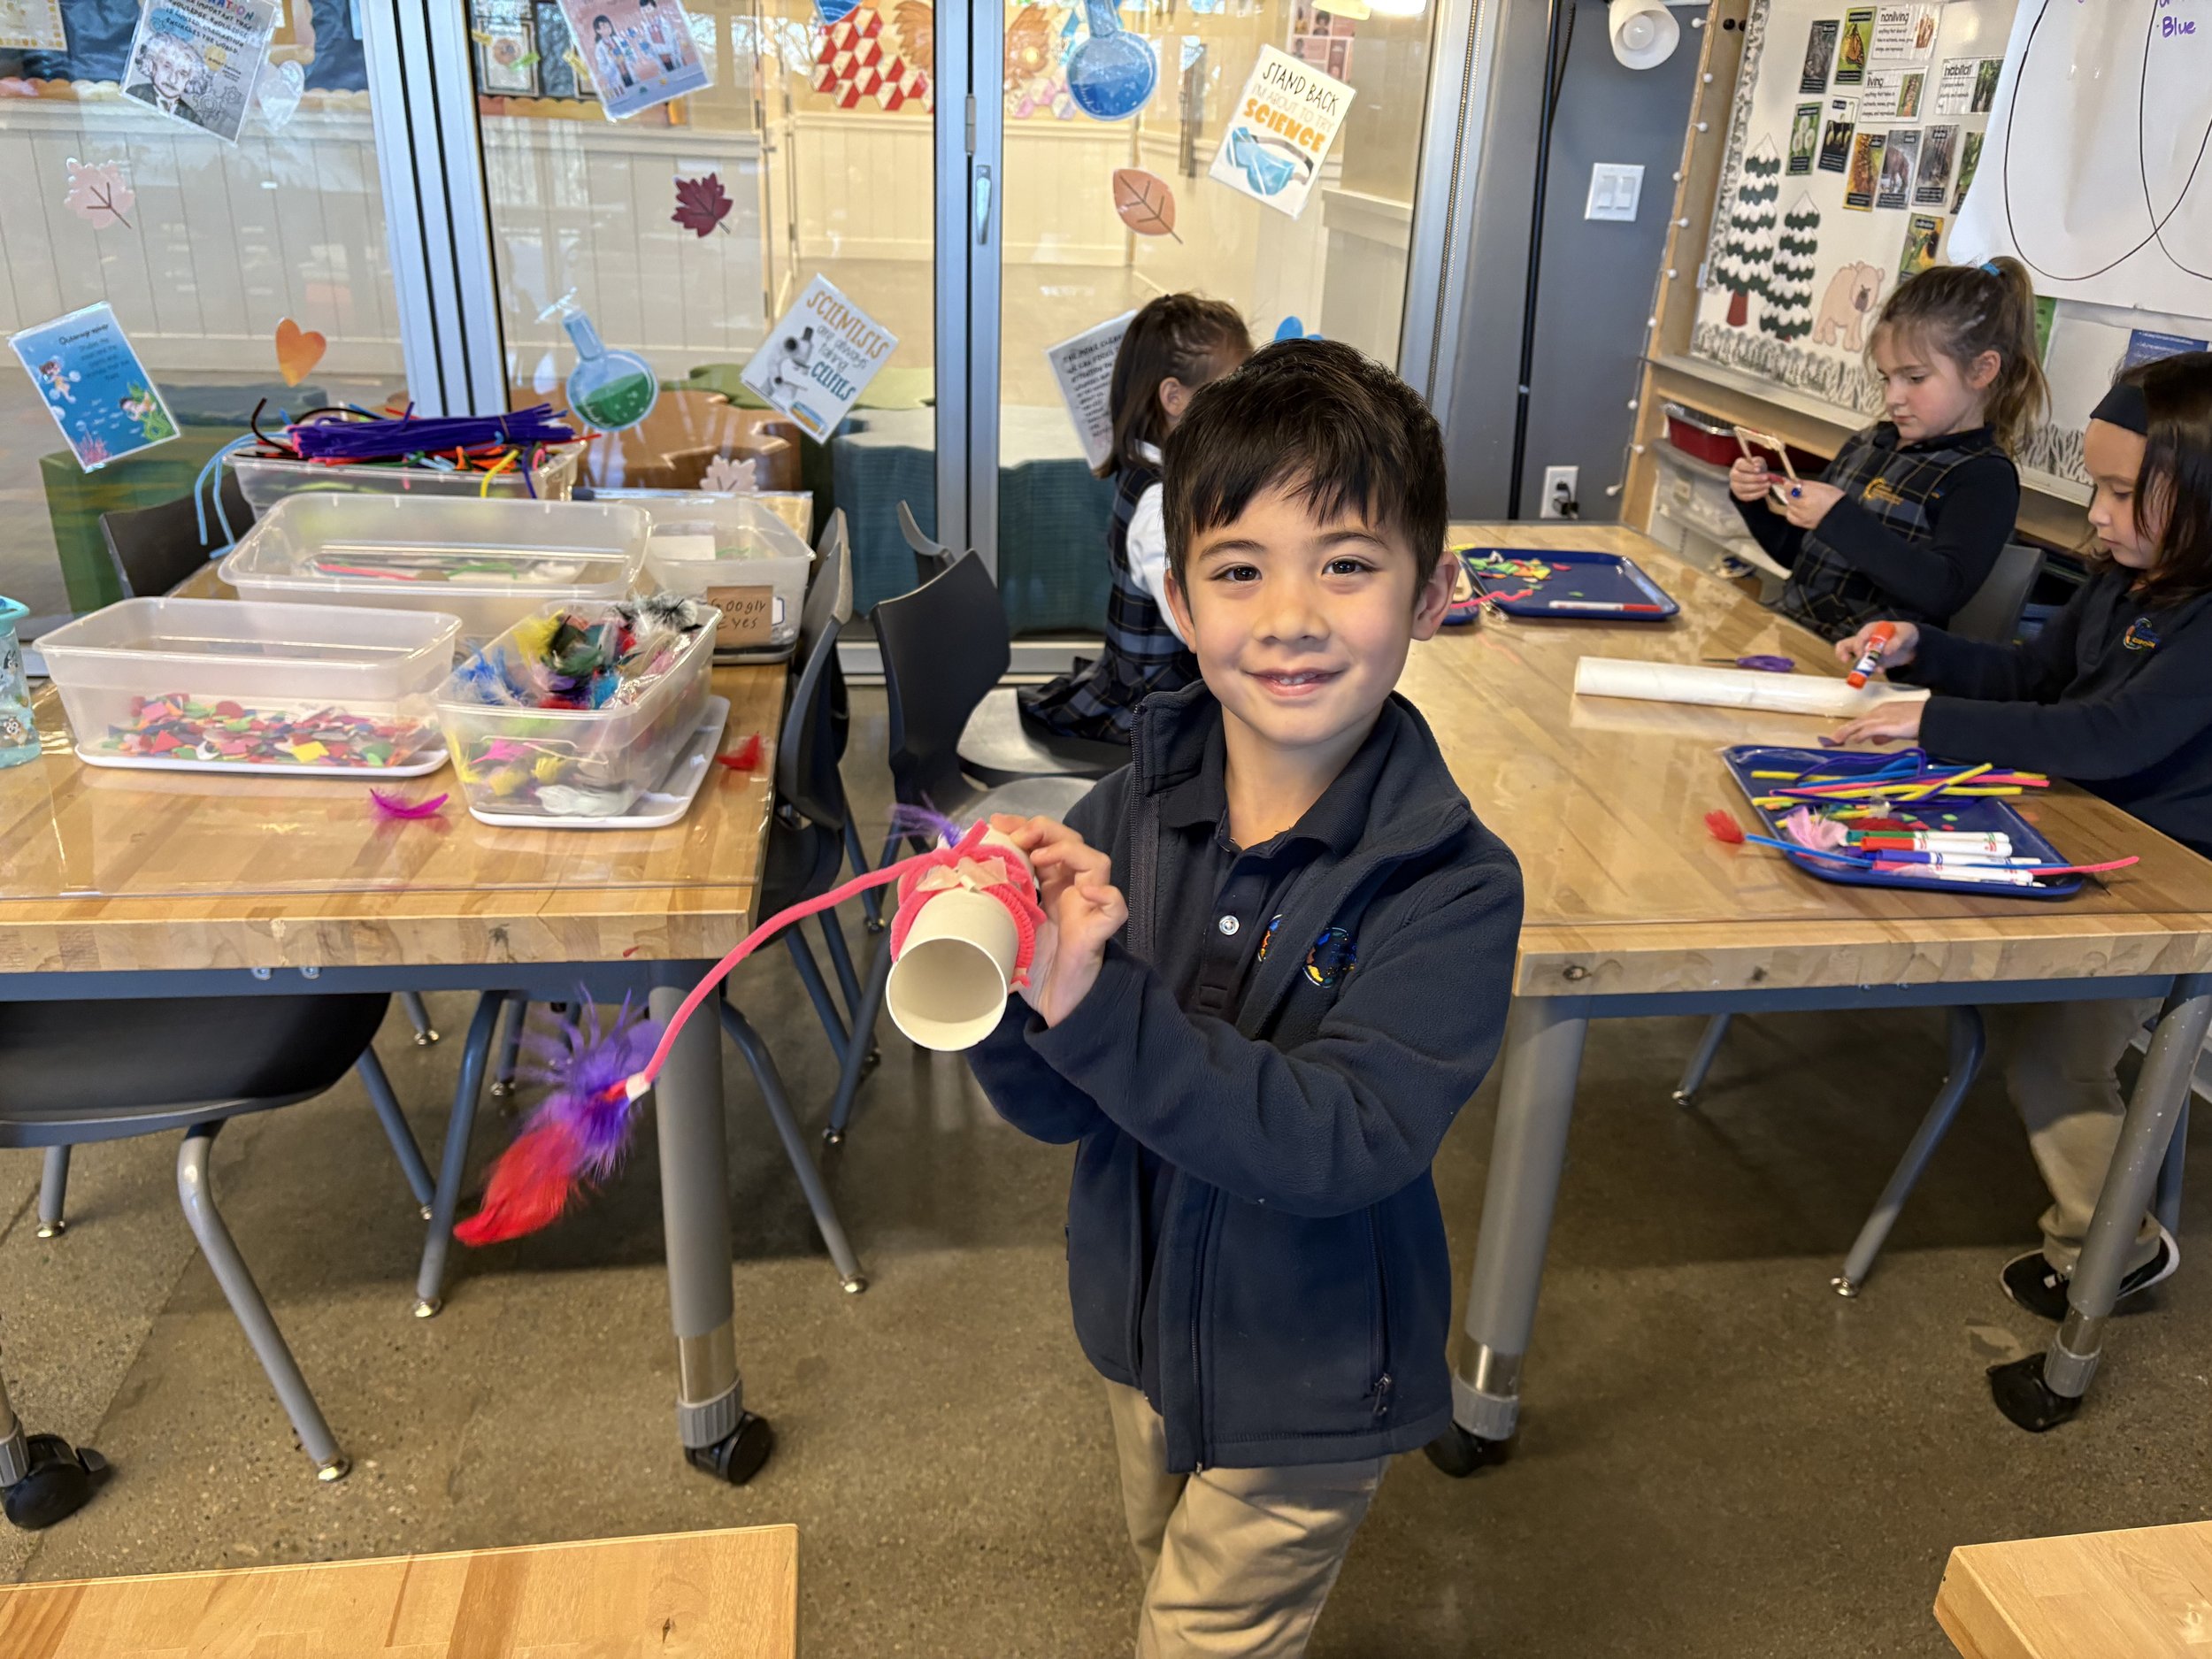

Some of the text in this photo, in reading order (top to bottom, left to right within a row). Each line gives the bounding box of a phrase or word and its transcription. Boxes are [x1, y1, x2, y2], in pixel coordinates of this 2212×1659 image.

[1880, 11, 1909, 25] nonliving
[2162, 16, 2196, 38] Blue
[1867, 76, 1884, 88] living
[1944, 64, 1972, 76] habitat
[1263, 62, 1340, 116] STAND BACK
[1266, 90, 1299, 112] ABOUT
[1300, 106, 1315, 122] TO
[1243, 98, 1326, 152] SCIENCE
[807, 290, 889, 359] SCIENTISTS
[817, 325, 869, 369] are always
[818, 342, 849, 372] taking
